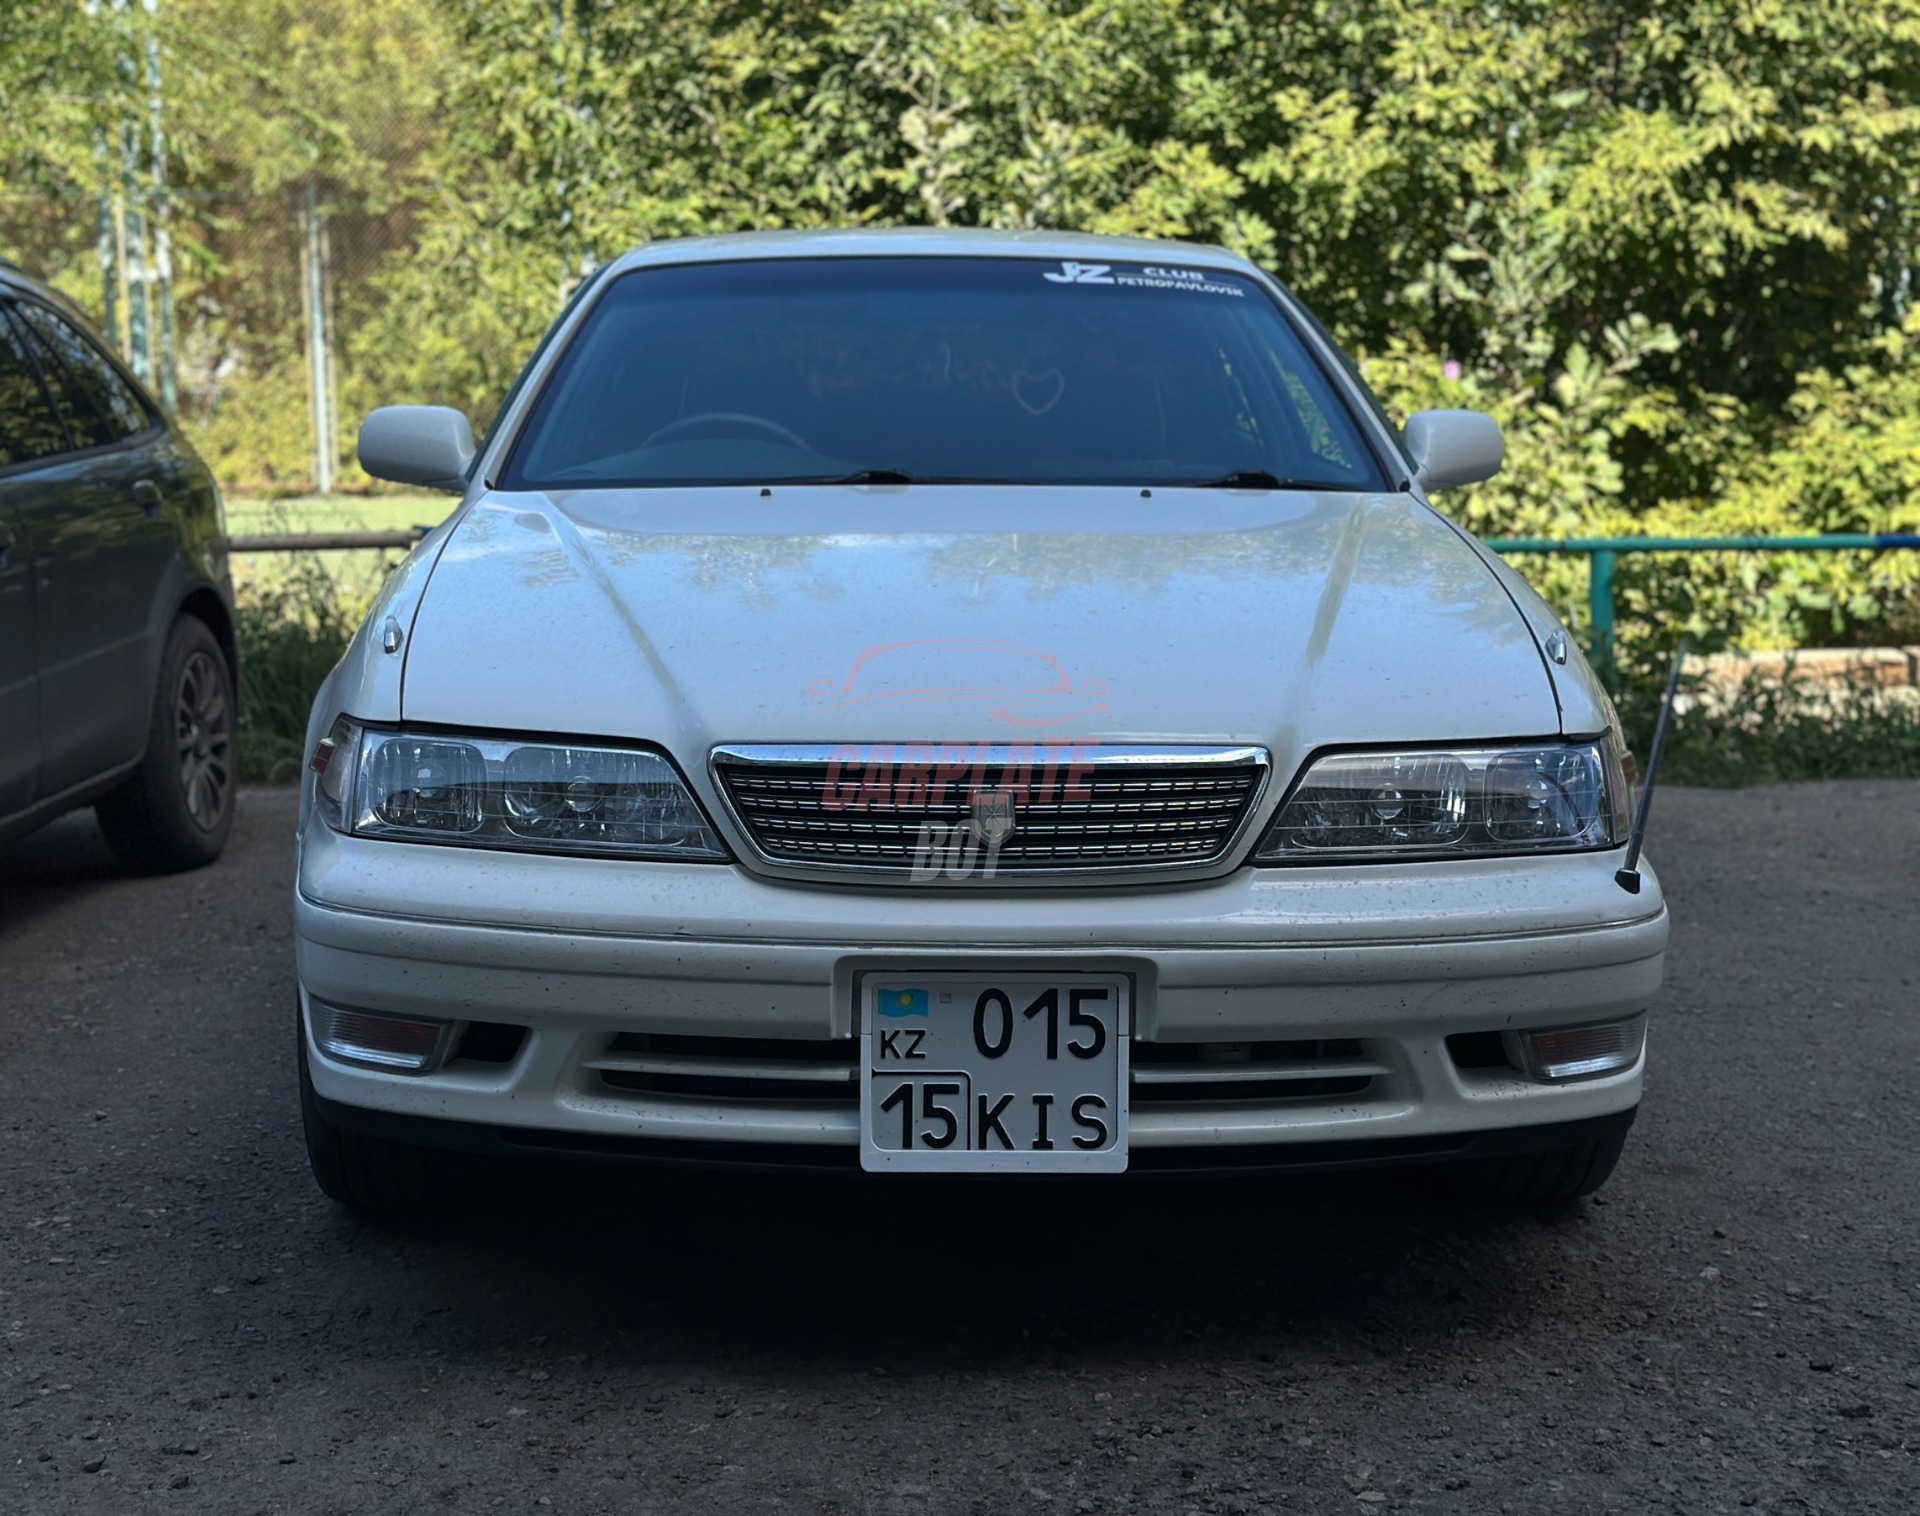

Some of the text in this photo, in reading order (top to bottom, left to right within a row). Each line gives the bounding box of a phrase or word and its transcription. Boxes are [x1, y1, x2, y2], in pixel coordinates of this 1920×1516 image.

[1043, 261, 1115, 284] JZ
[1117, 277, 1244, 297] PETROPAVLOVSK
[1143, 267, 1205, 281] CLUB
[973, 988, 1109, 1060] 015
[880, 1029, 926, 1059] KZ
[880, 1082, 960, 1150] 15
[978, 1094, 1108, 1150] KIS
